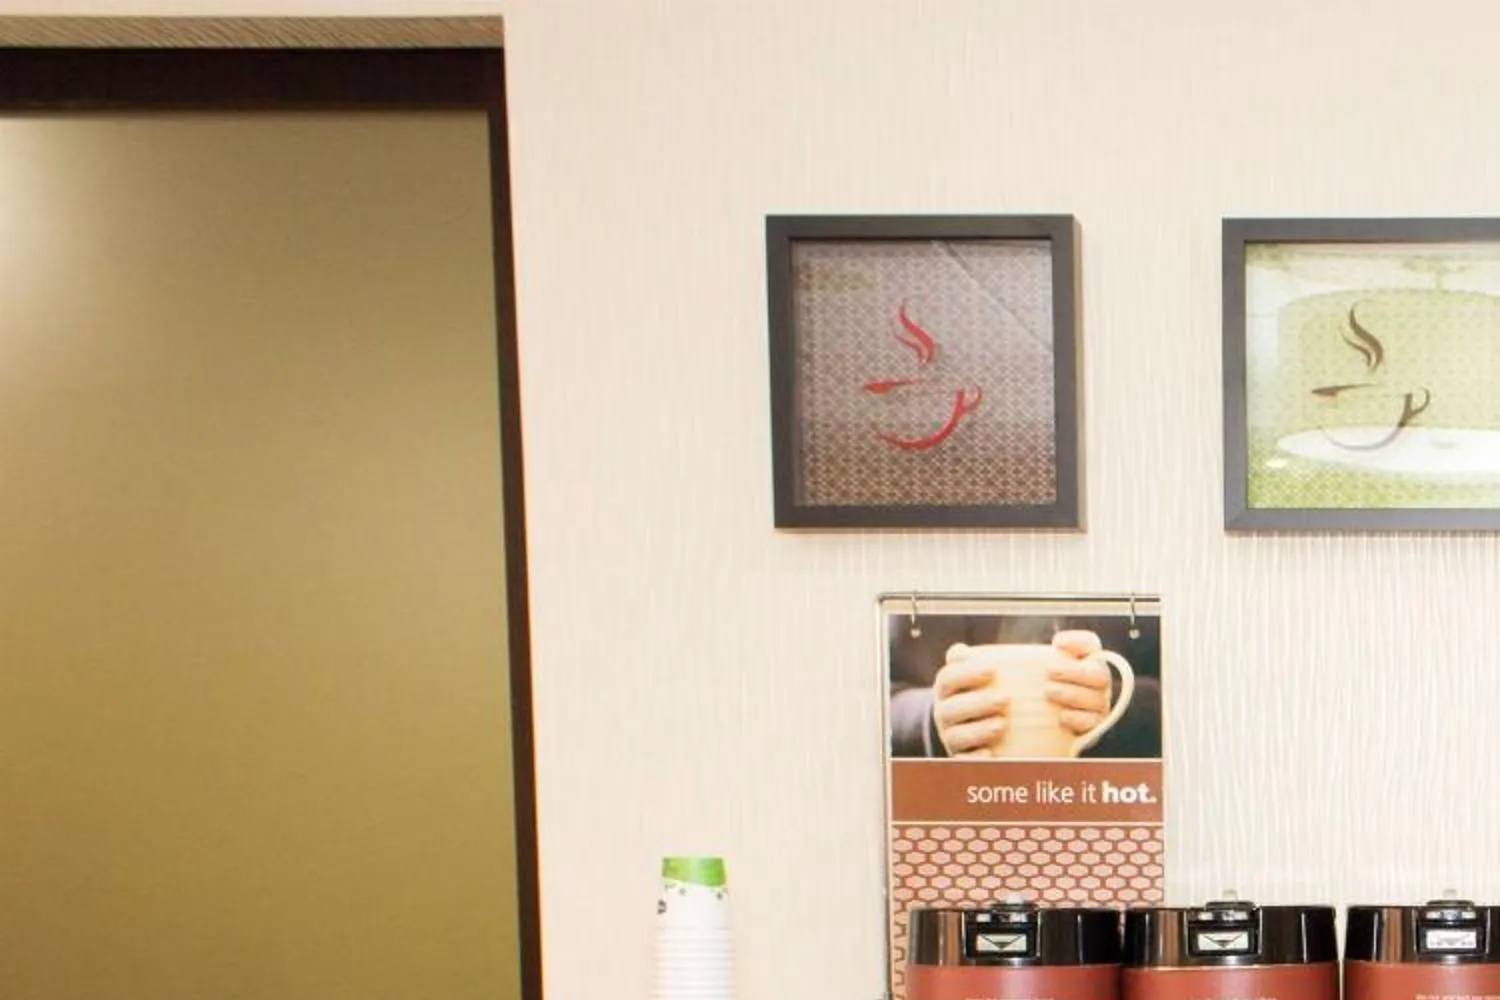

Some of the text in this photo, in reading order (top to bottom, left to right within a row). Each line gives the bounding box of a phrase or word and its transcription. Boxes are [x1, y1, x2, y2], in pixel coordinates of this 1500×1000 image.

[966, 781, 1157, 804] some like it hot.
